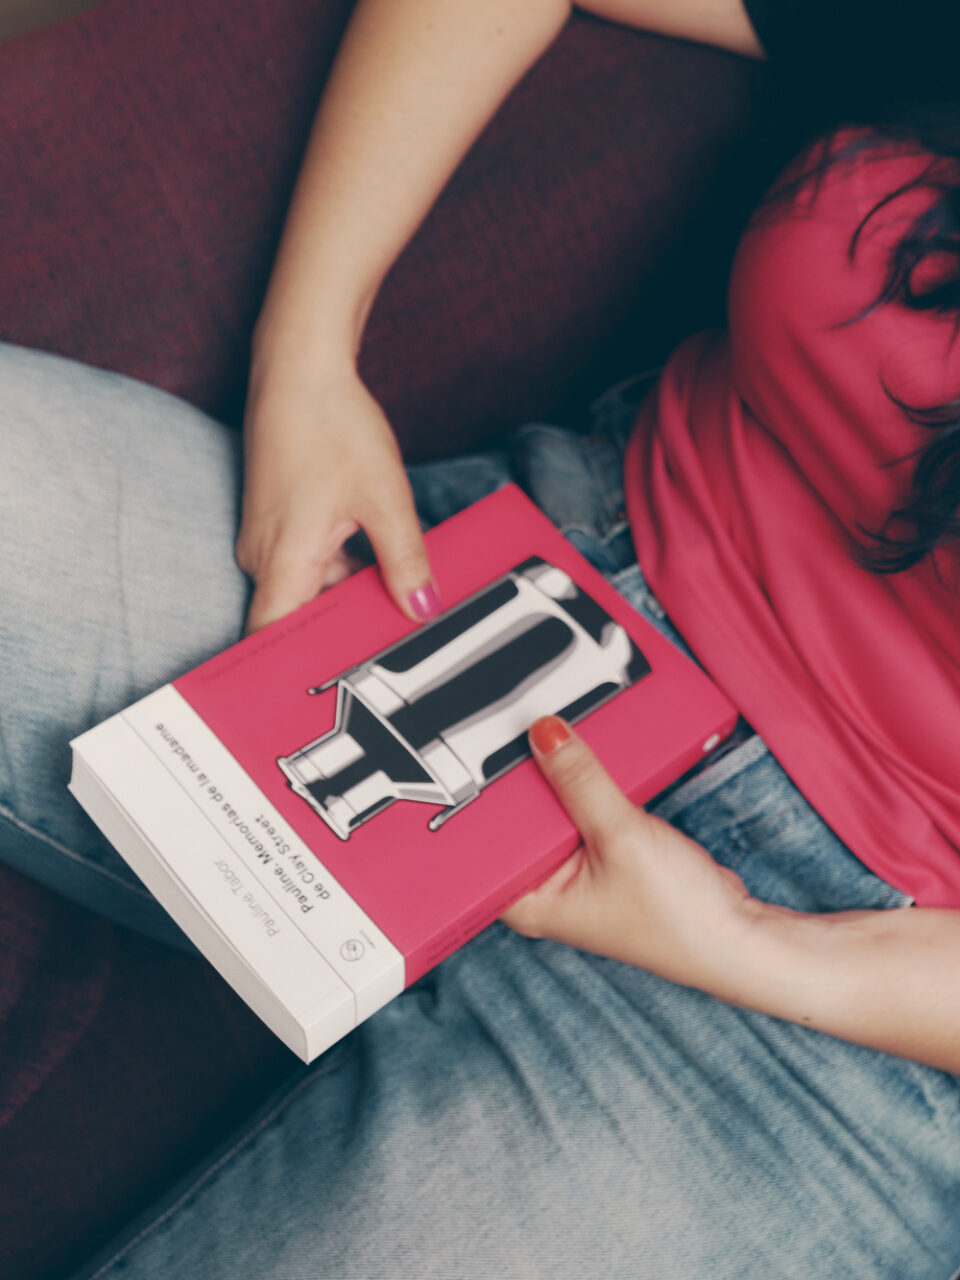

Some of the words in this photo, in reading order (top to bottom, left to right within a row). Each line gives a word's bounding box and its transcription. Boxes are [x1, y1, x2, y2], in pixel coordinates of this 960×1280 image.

[156, 724, 199, 772] madame
[198, 773, 209, 787] la
[208, 786, 223, 802] de
[222, 803, 273, 864] Memorias
[255, 814, 290, 855] Street
[214, 860, 244, 895] Tabor
[274, 864, 314, 913] Pauline.
[288, 855, 315, 884] Clay
[314, 883, 330, 899] de
[243, 893, 280, 937] Pauline
